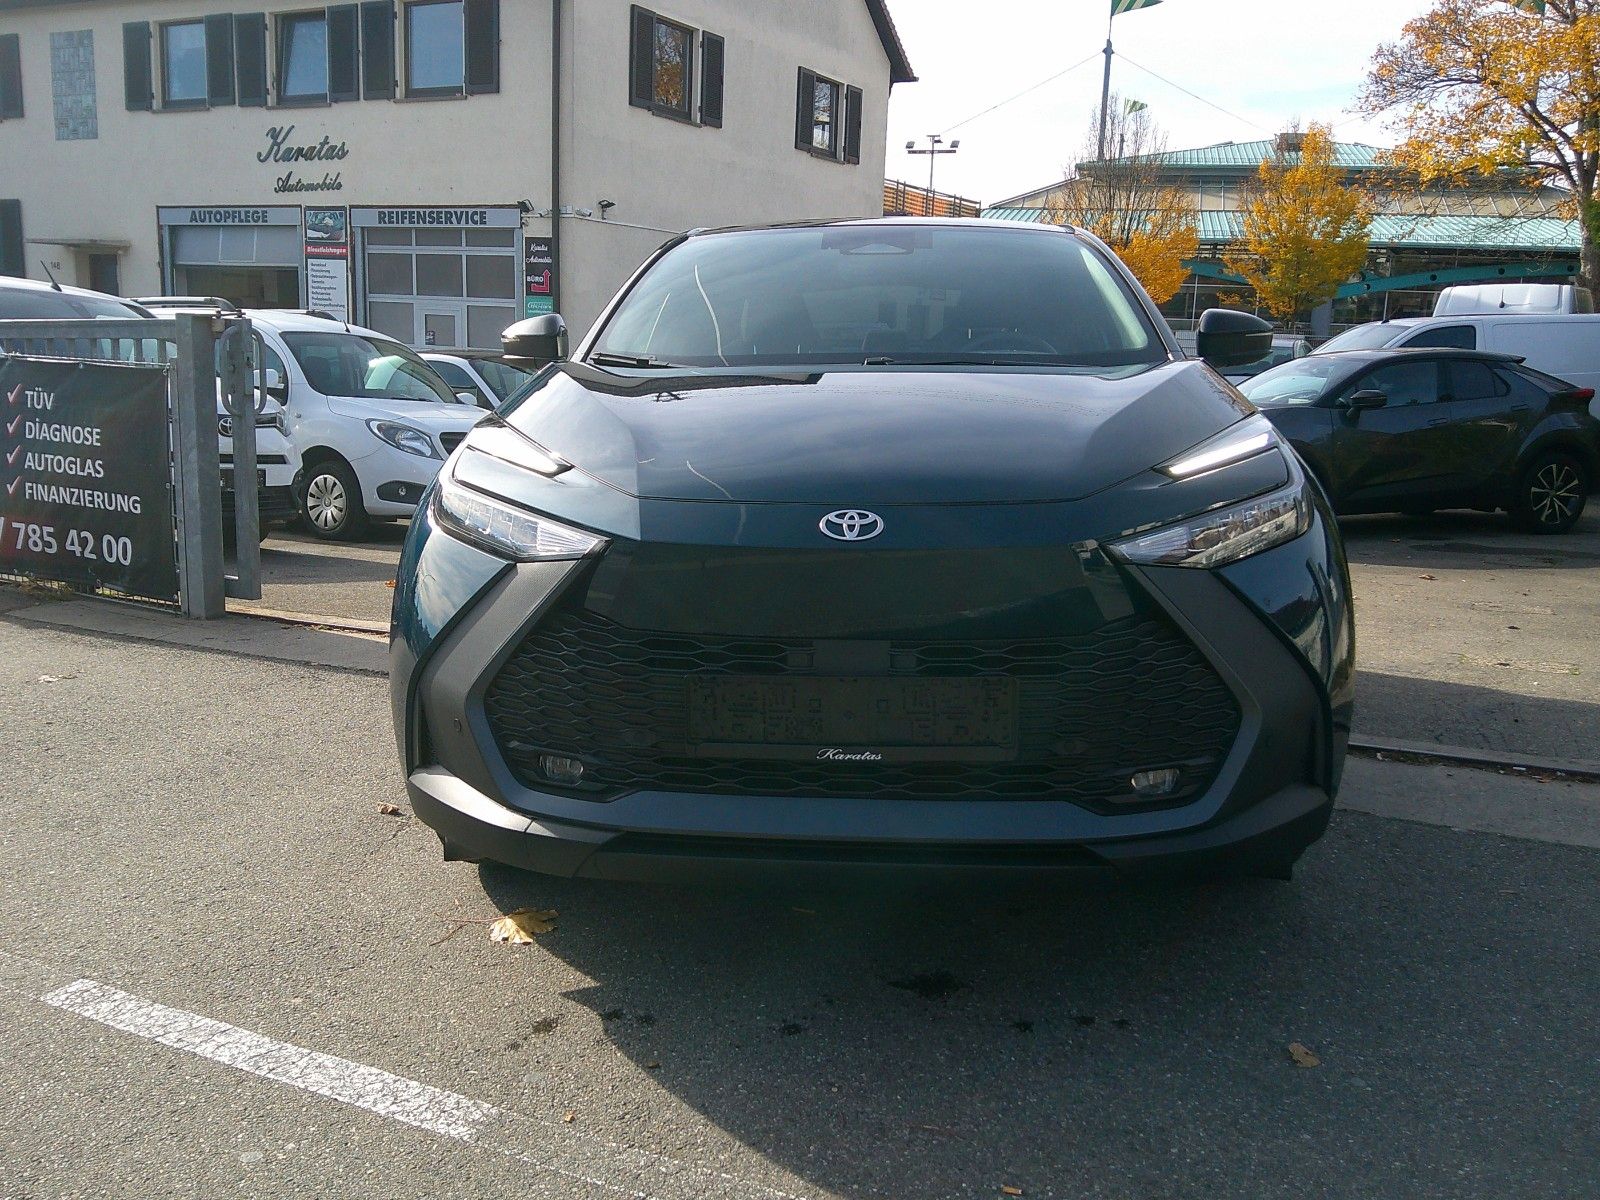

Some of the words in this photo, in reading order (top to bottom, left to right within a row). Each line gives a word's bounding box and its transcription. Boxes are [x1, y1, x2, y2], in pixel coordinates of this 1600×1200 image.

[257, 124, 350, 163] Karatas
[273, 170, 343, 193] Automobile
[189, 209, 268, 223] AUTOPFLEGE
[377, 210, 487, 225] REIFENSERVICE
[526, 275, 544, 283] BÜRO
[25, 387, 55, 410] TÜV
[24, 452, 104, 478] AUTOGLAS
[25, 482, 142, 514] FINANZIERUNG
[11, 522, 58, 554] 785
[65, 529, 97, 560] 42
[102, 534, 132, 566] 00
[816, 748, 882, 760] Karatas
